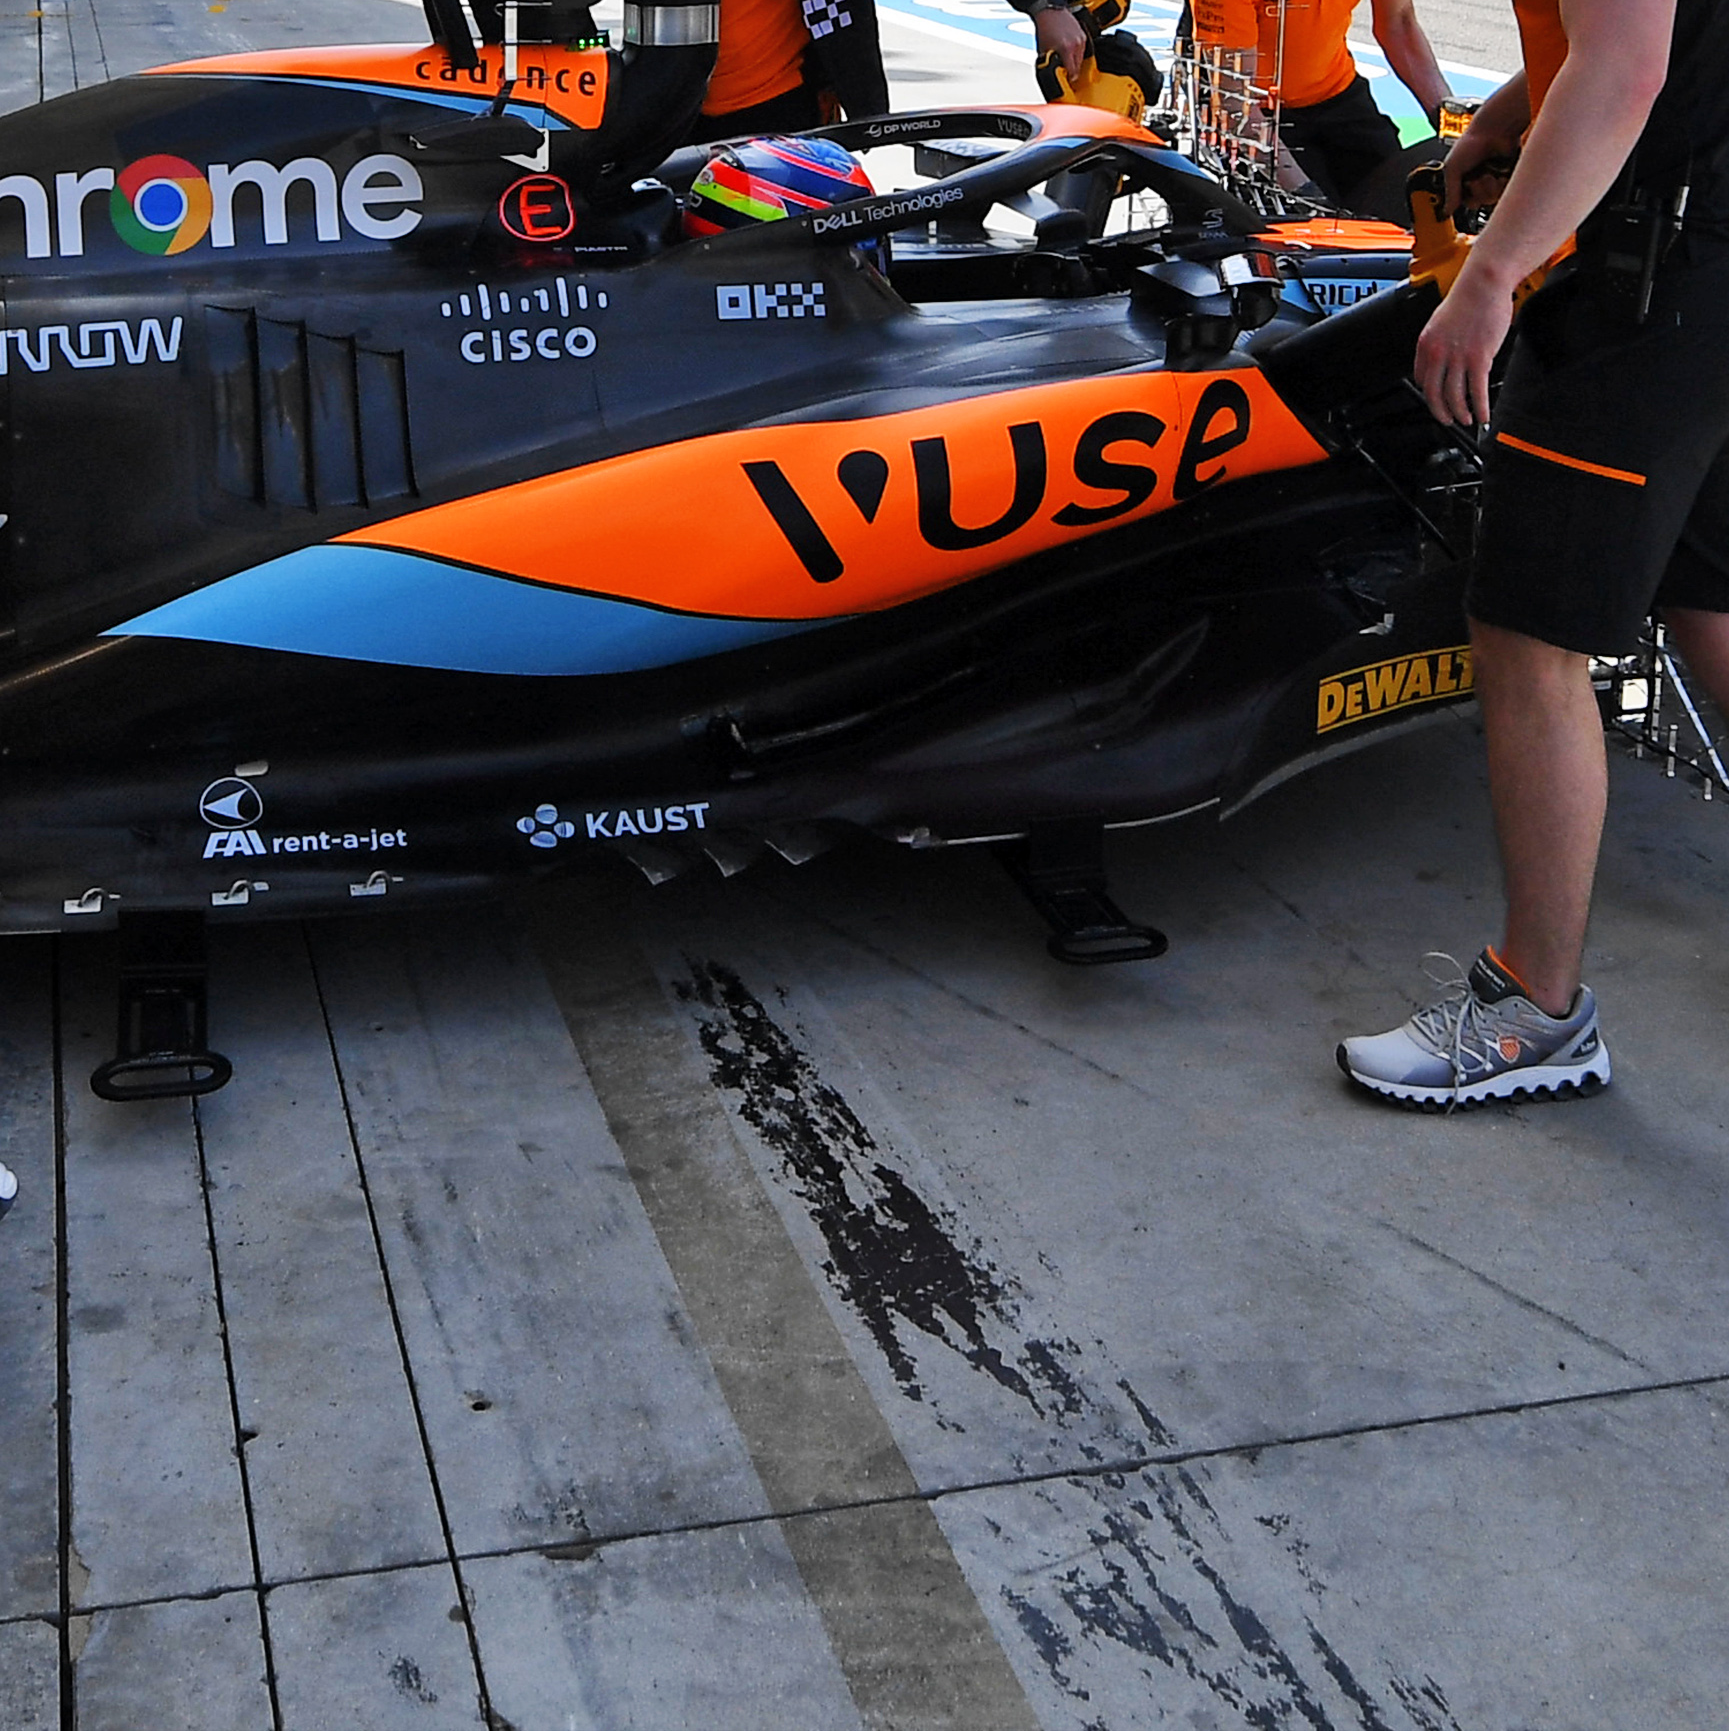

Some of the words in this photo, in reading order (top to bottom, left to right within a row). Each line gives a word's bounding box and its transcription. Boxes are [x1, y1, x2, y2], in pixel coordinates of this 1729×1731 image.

[884, 122, 899, 134] DP
[901, 120, 941, 132] WORLD
[519, 184, 562, 236] E
[813, 210, 863, 234] DELL
[864, 187, 963, 221] Technologies
[716, 282, 827, 320] OKX
[1308, 281, 1378, 306] RICH
[585, 802, 710, 839] KAUST
[272, 829, 408, 855] rent-a-jet
